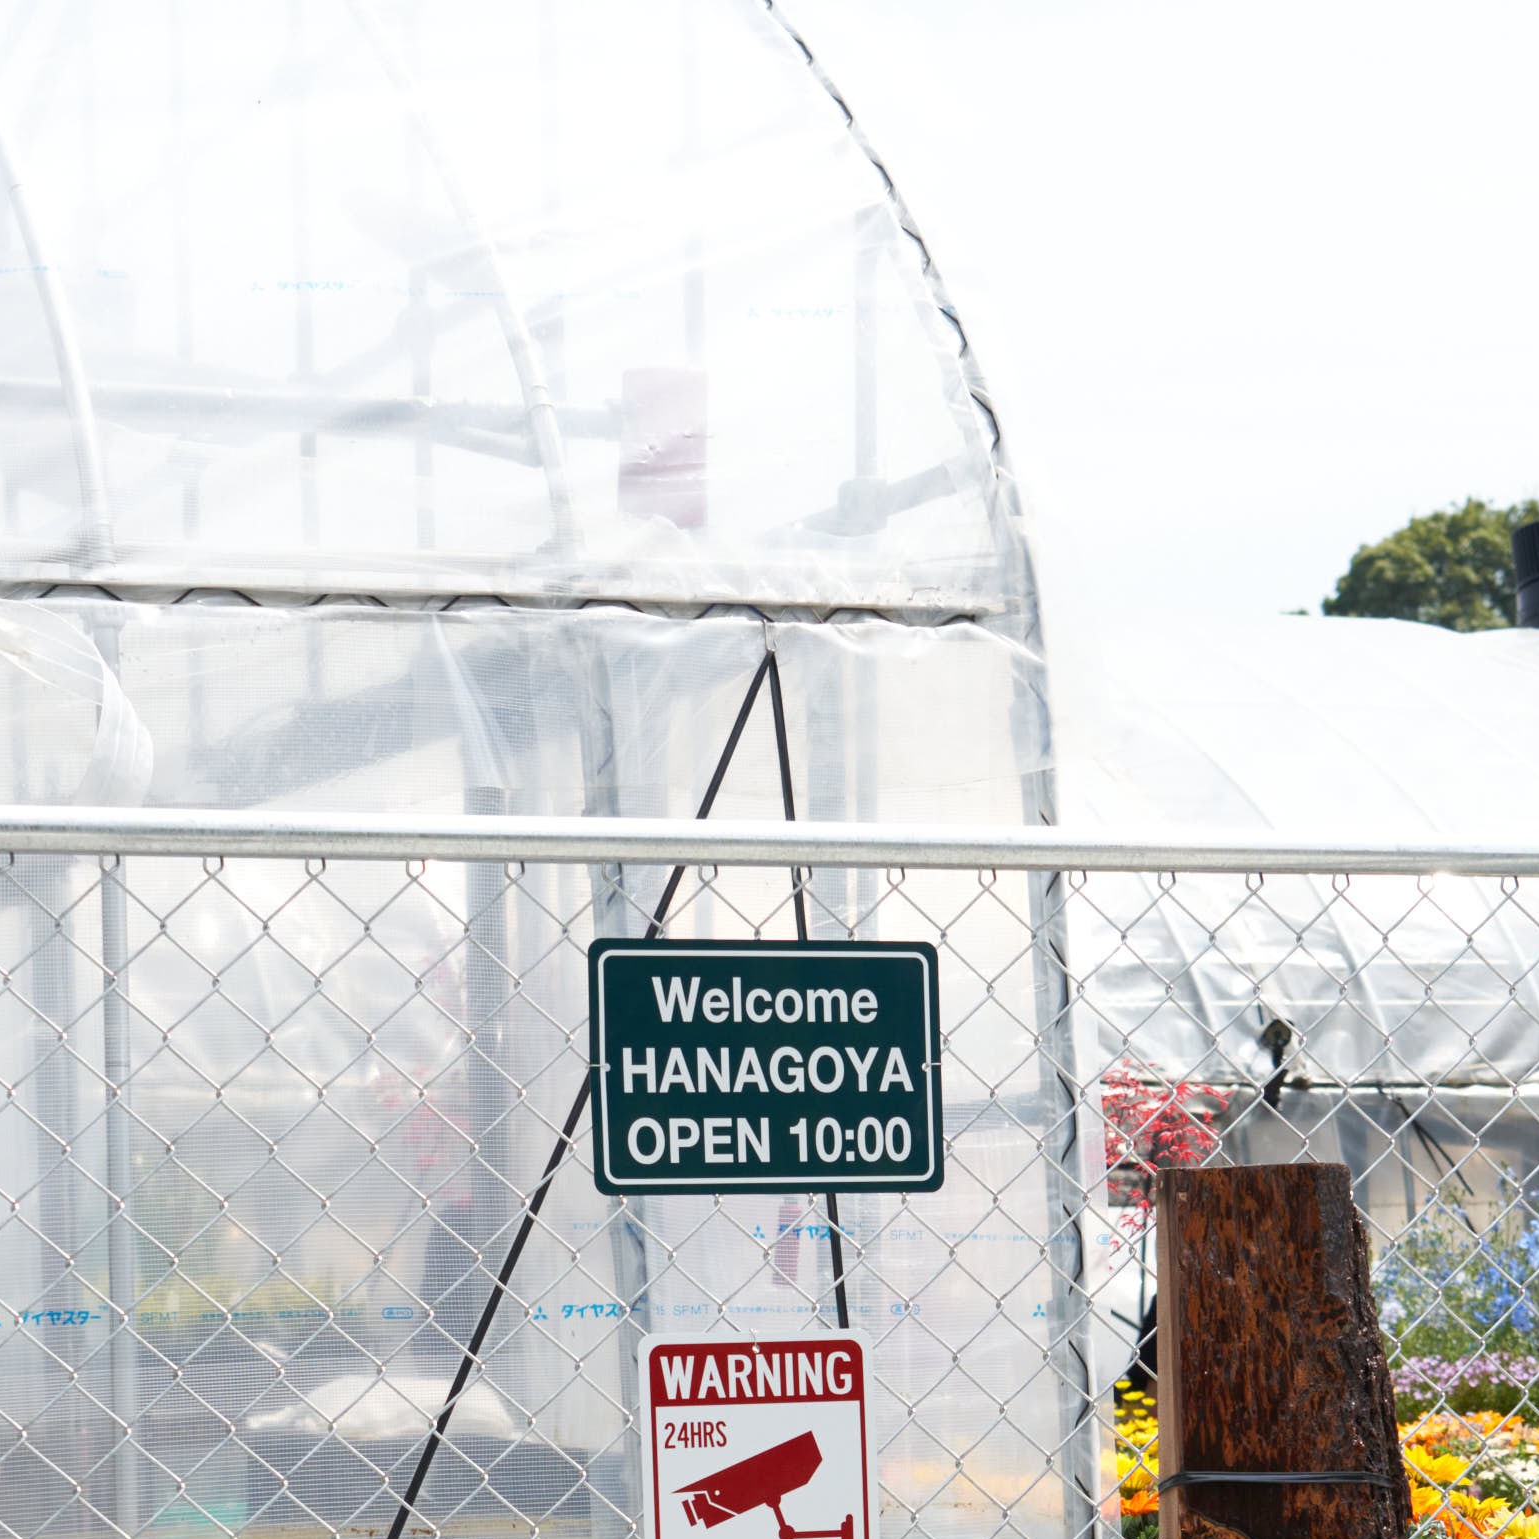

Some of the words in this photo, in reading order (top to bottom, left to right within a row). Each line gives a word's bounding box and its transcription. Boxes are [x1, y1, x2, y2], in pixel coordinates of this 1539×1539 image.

[651, 976, 878, 1023] Welcome
[621, 1046, 914, 1094] HANAGOYA
[627, 1117, 770, 1165] OPEN
[789, 1116, 912, 1163] 10:00
[659, 1351, 853, 1400] WARNING
[664, 1421, 728, 1449] 24HRS
